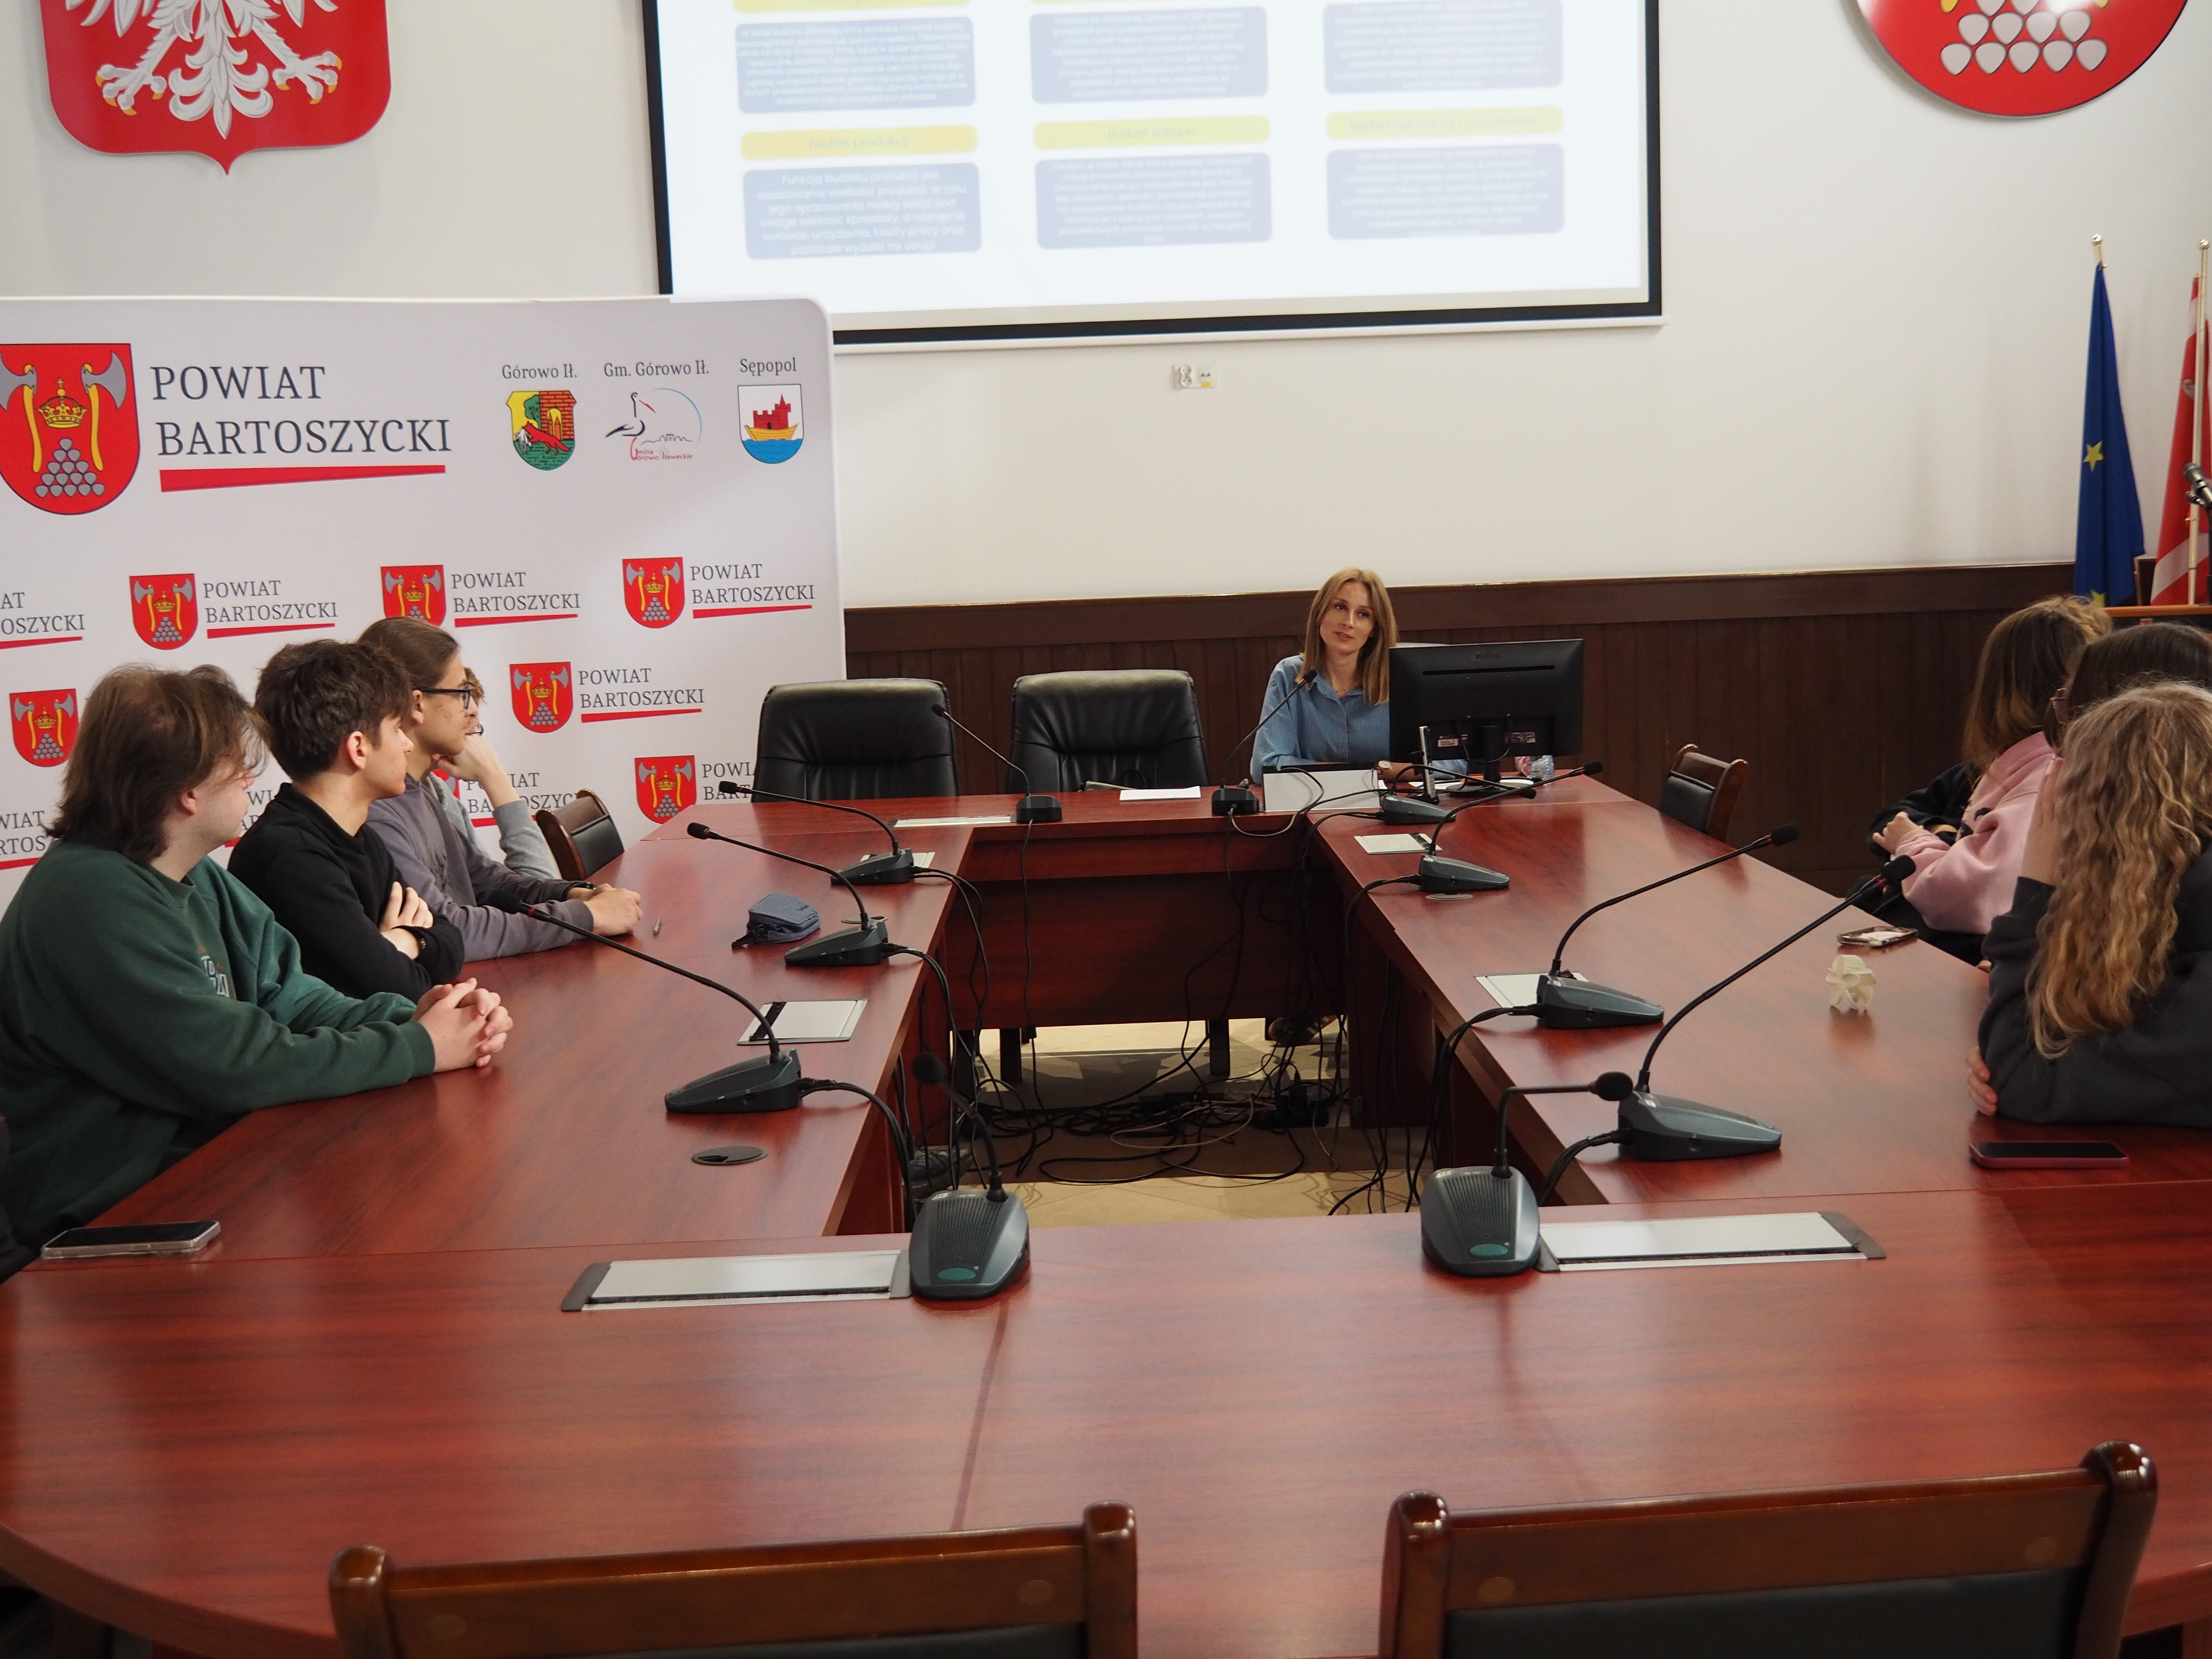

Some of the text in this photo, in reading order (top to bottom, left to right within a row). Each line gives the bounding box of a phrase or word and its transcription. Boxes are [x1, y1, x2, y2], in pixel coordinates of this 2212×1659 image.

[502, 364, 577, 380] Górowo Ił.
[604, 360, 710, 377] Gm. Górowo Ił.
[741, 358, 797, 377] Sępopol
[150, 366, 326, 400] POWIAT
[156, 420, 452, 456] BARTOSZYCKI
[451, 572, 526, 589] POWIAT
[691, 564, 763, 581] POWIAT
[204, 580, 281, 599] POWIAT
[692, 585, 815, 604] BARTOSZYCKI
[205, 602, 338, 624] BARTOSZYCKI
[454, 594, 581, 613] BARTOSZYCKI
[1, 614, 85, 635] OSZYCKI
[578, 668, 652, 686] POWIAT
[580, 689, 705, 709] BARTOSZYCKI
[701, 762, 755, 778] POWI
[467, 772, 540, 791] PIAT
[0, 810, 45, 829] WIAT
